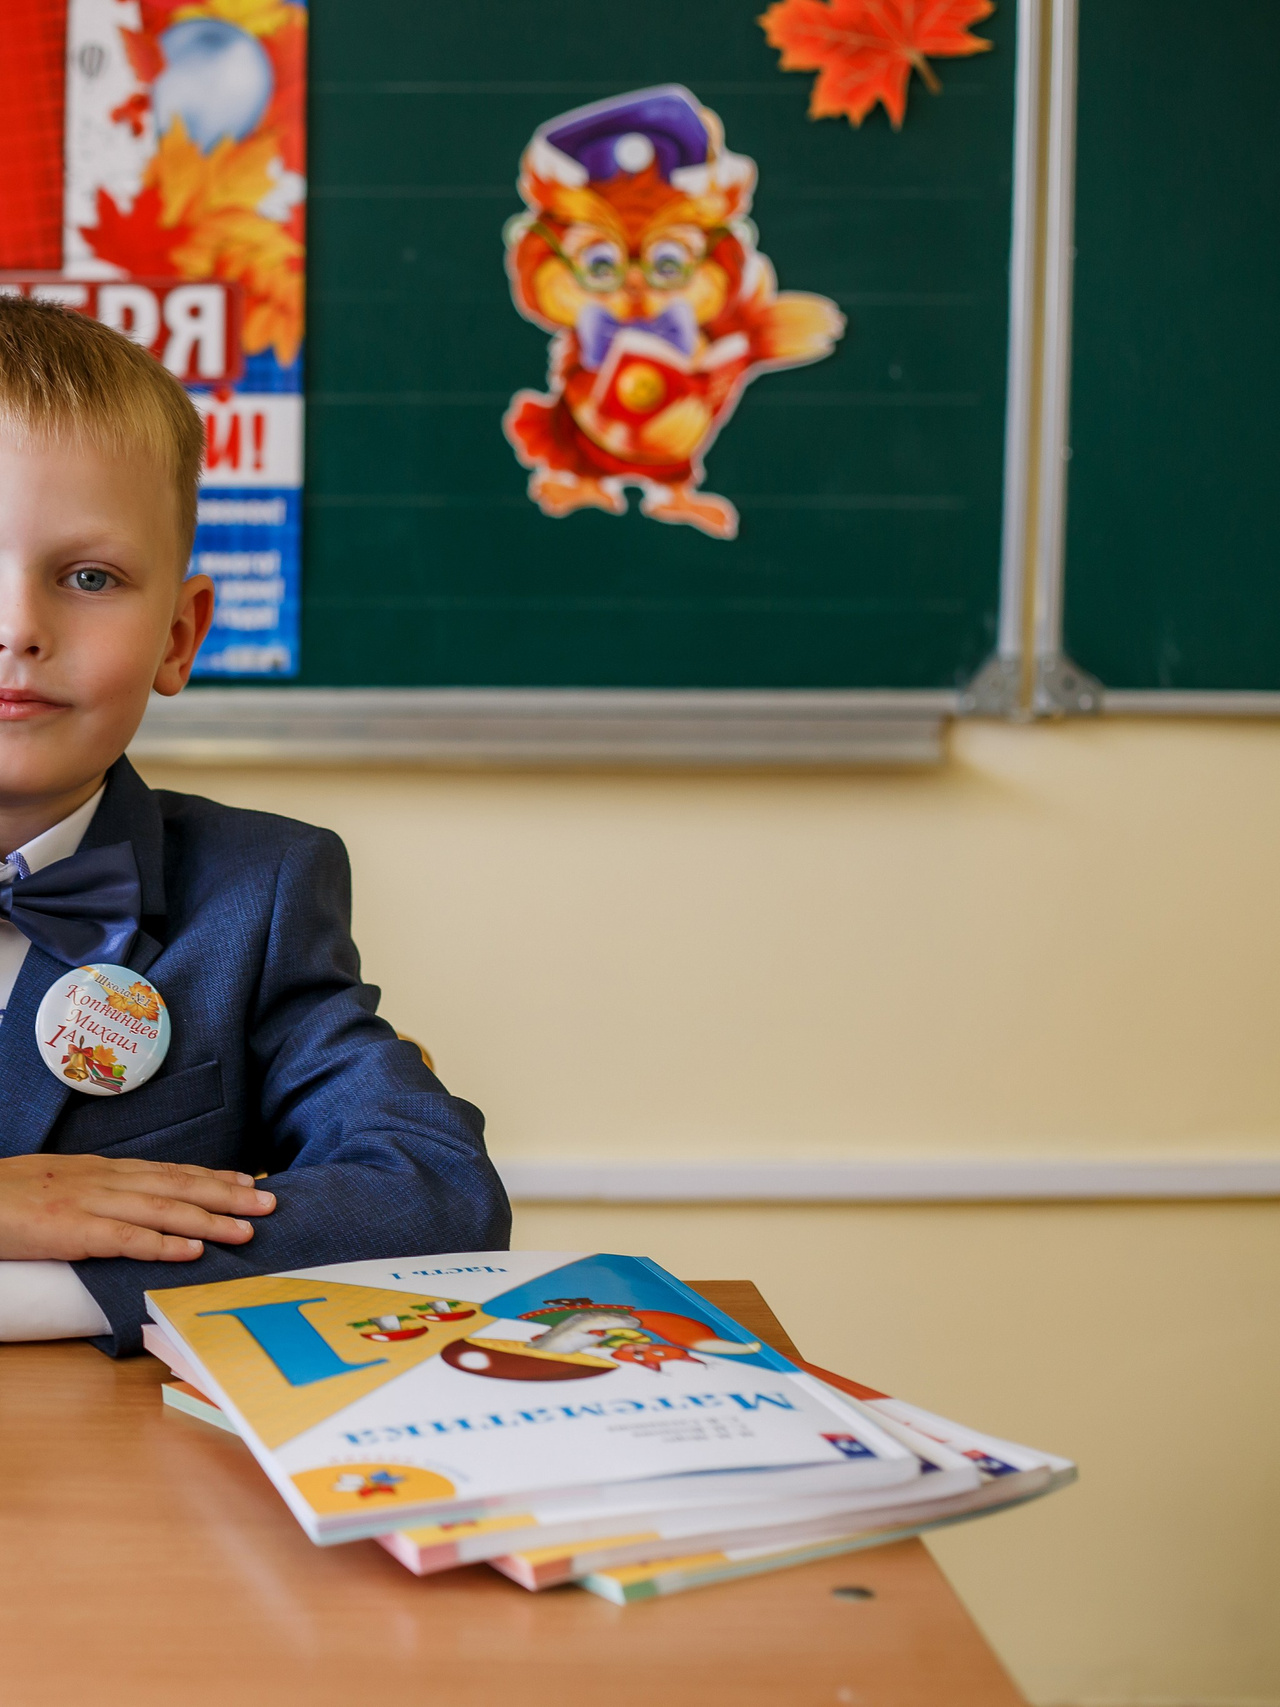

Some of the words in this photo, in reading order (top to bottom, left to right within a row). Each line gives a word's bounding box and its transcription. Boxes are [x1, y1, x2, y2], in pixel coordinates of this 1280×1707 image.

[94, 973, 132, 998] Школа
[65, 1009, 138, 1054] Михаил
[388, 1271, 406, 1280] 1
[411, 1265, 509, 1276] Часть
[195, 1297, 390, 1388] 1
[340, 1391, 802, 1448] Математика
